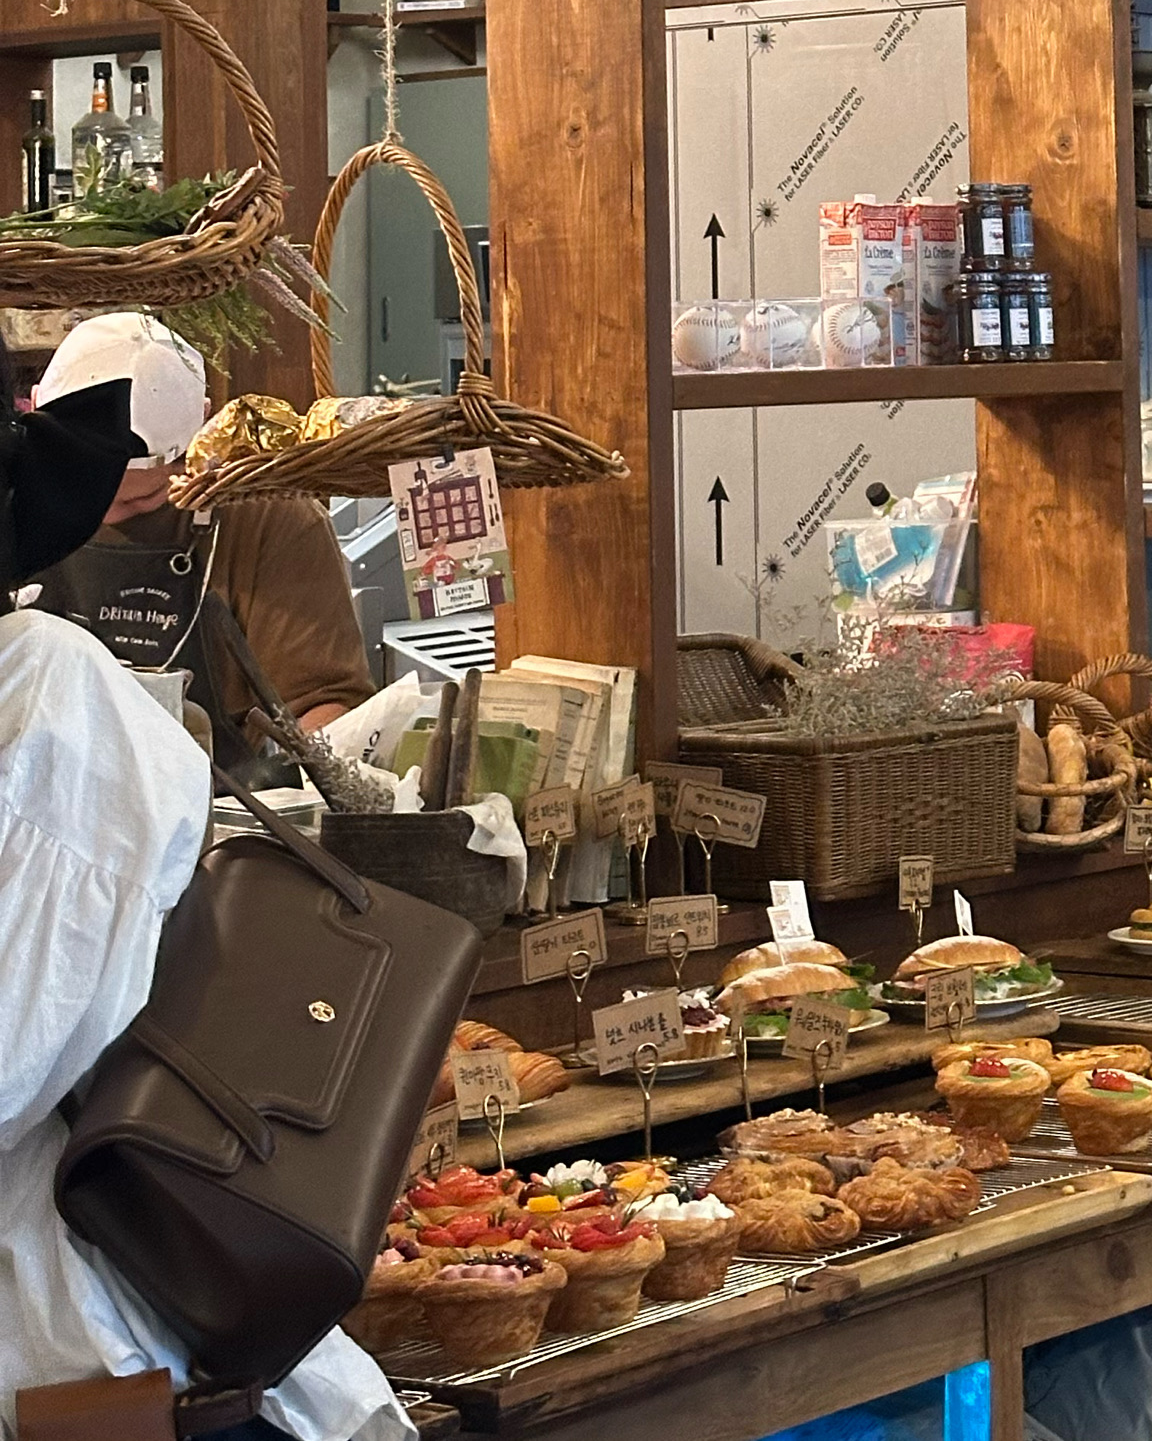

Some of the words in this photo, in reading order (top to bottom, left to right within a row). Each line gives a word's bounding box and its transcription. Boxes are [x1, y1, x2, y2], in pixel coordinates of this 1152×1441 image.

[777, 174, 793, 193] The
[827, 86, 858, 126] Solution
[794, 161, 816, 190] LASER
[832, 110, 854, 138] LASER
[927, 133, 951, 161] LASER
[951, 131, 966, 149] The
[782, 531, 799, 549] The
[834, 442, 865, 481] Solution
[800, 518, 822, 547] LASER
[838, 465, 860, 495] LASER
